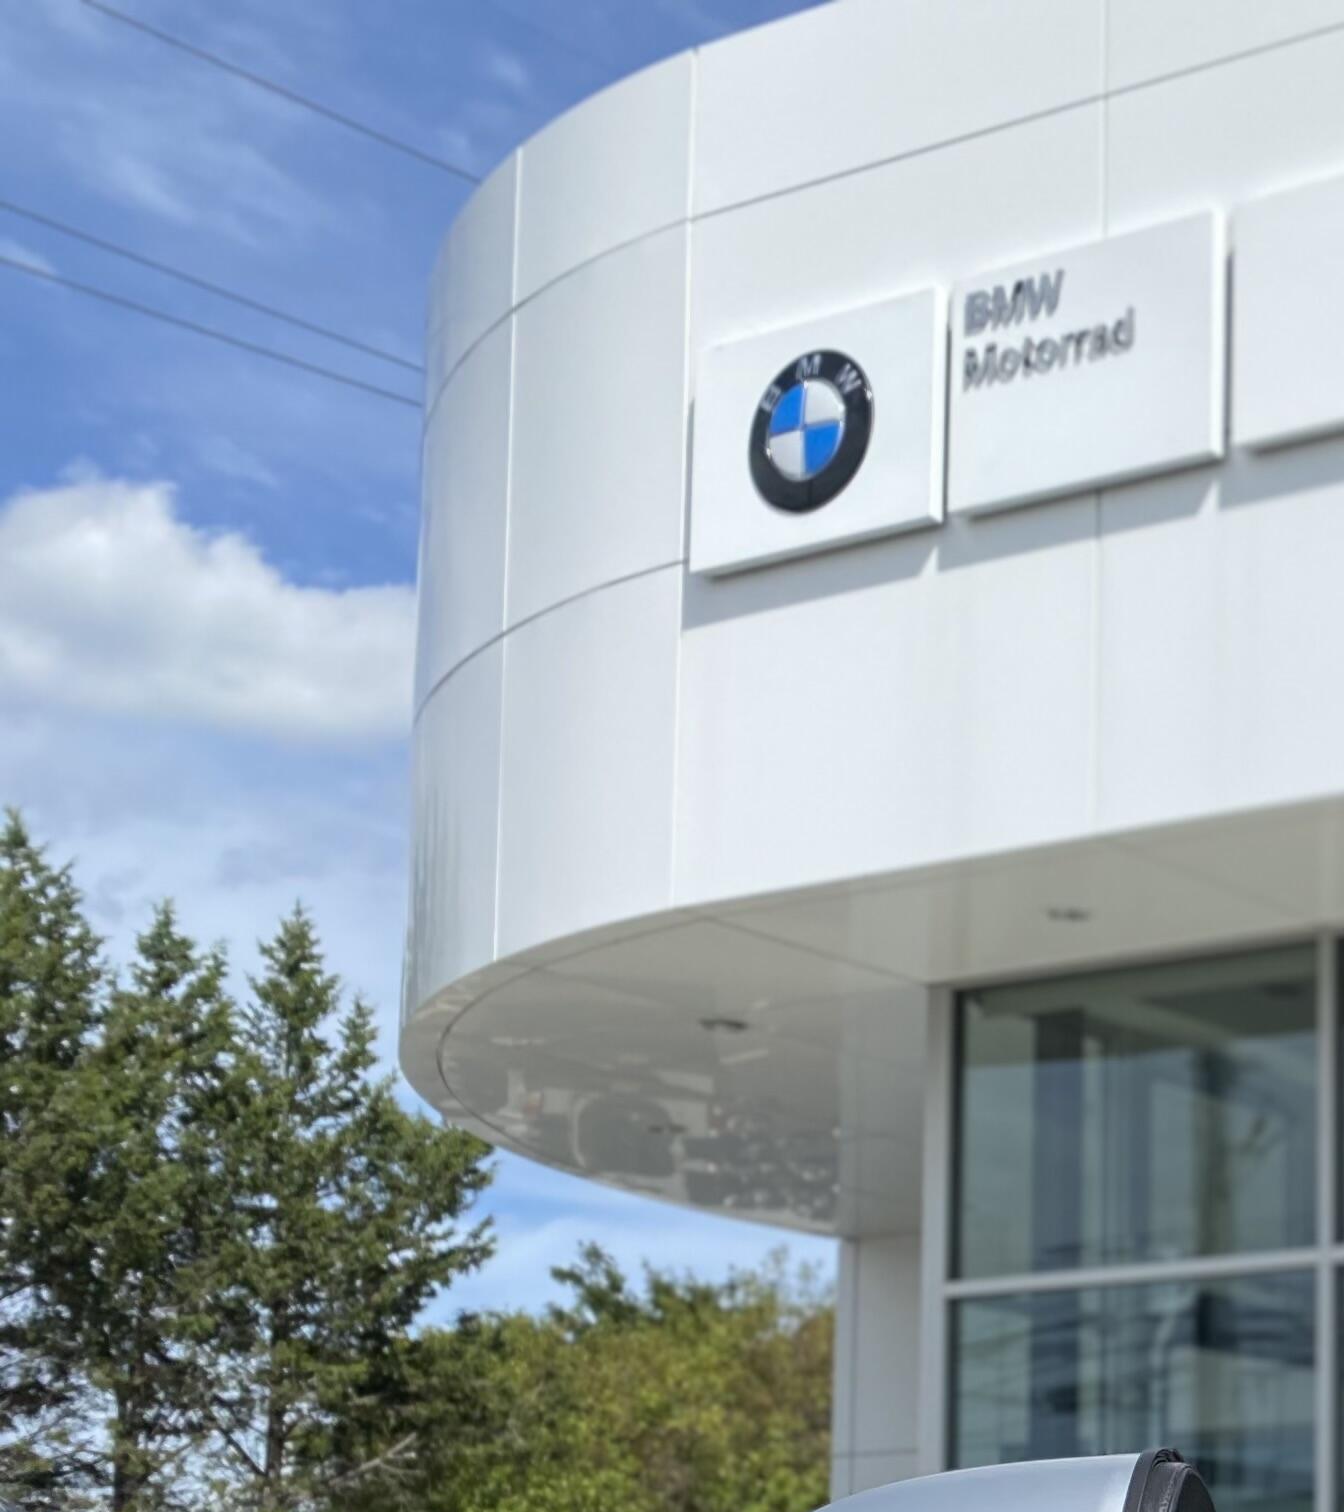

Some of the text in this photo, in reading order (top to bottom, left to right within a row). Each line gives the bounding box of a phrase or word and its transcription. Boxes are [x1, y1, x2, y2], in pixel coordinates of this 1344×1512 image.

[962, 269, 1066, 338] BMW
[760, 353, 862, 413] BMW
[962, 306, 1137, 392] Motorrad
